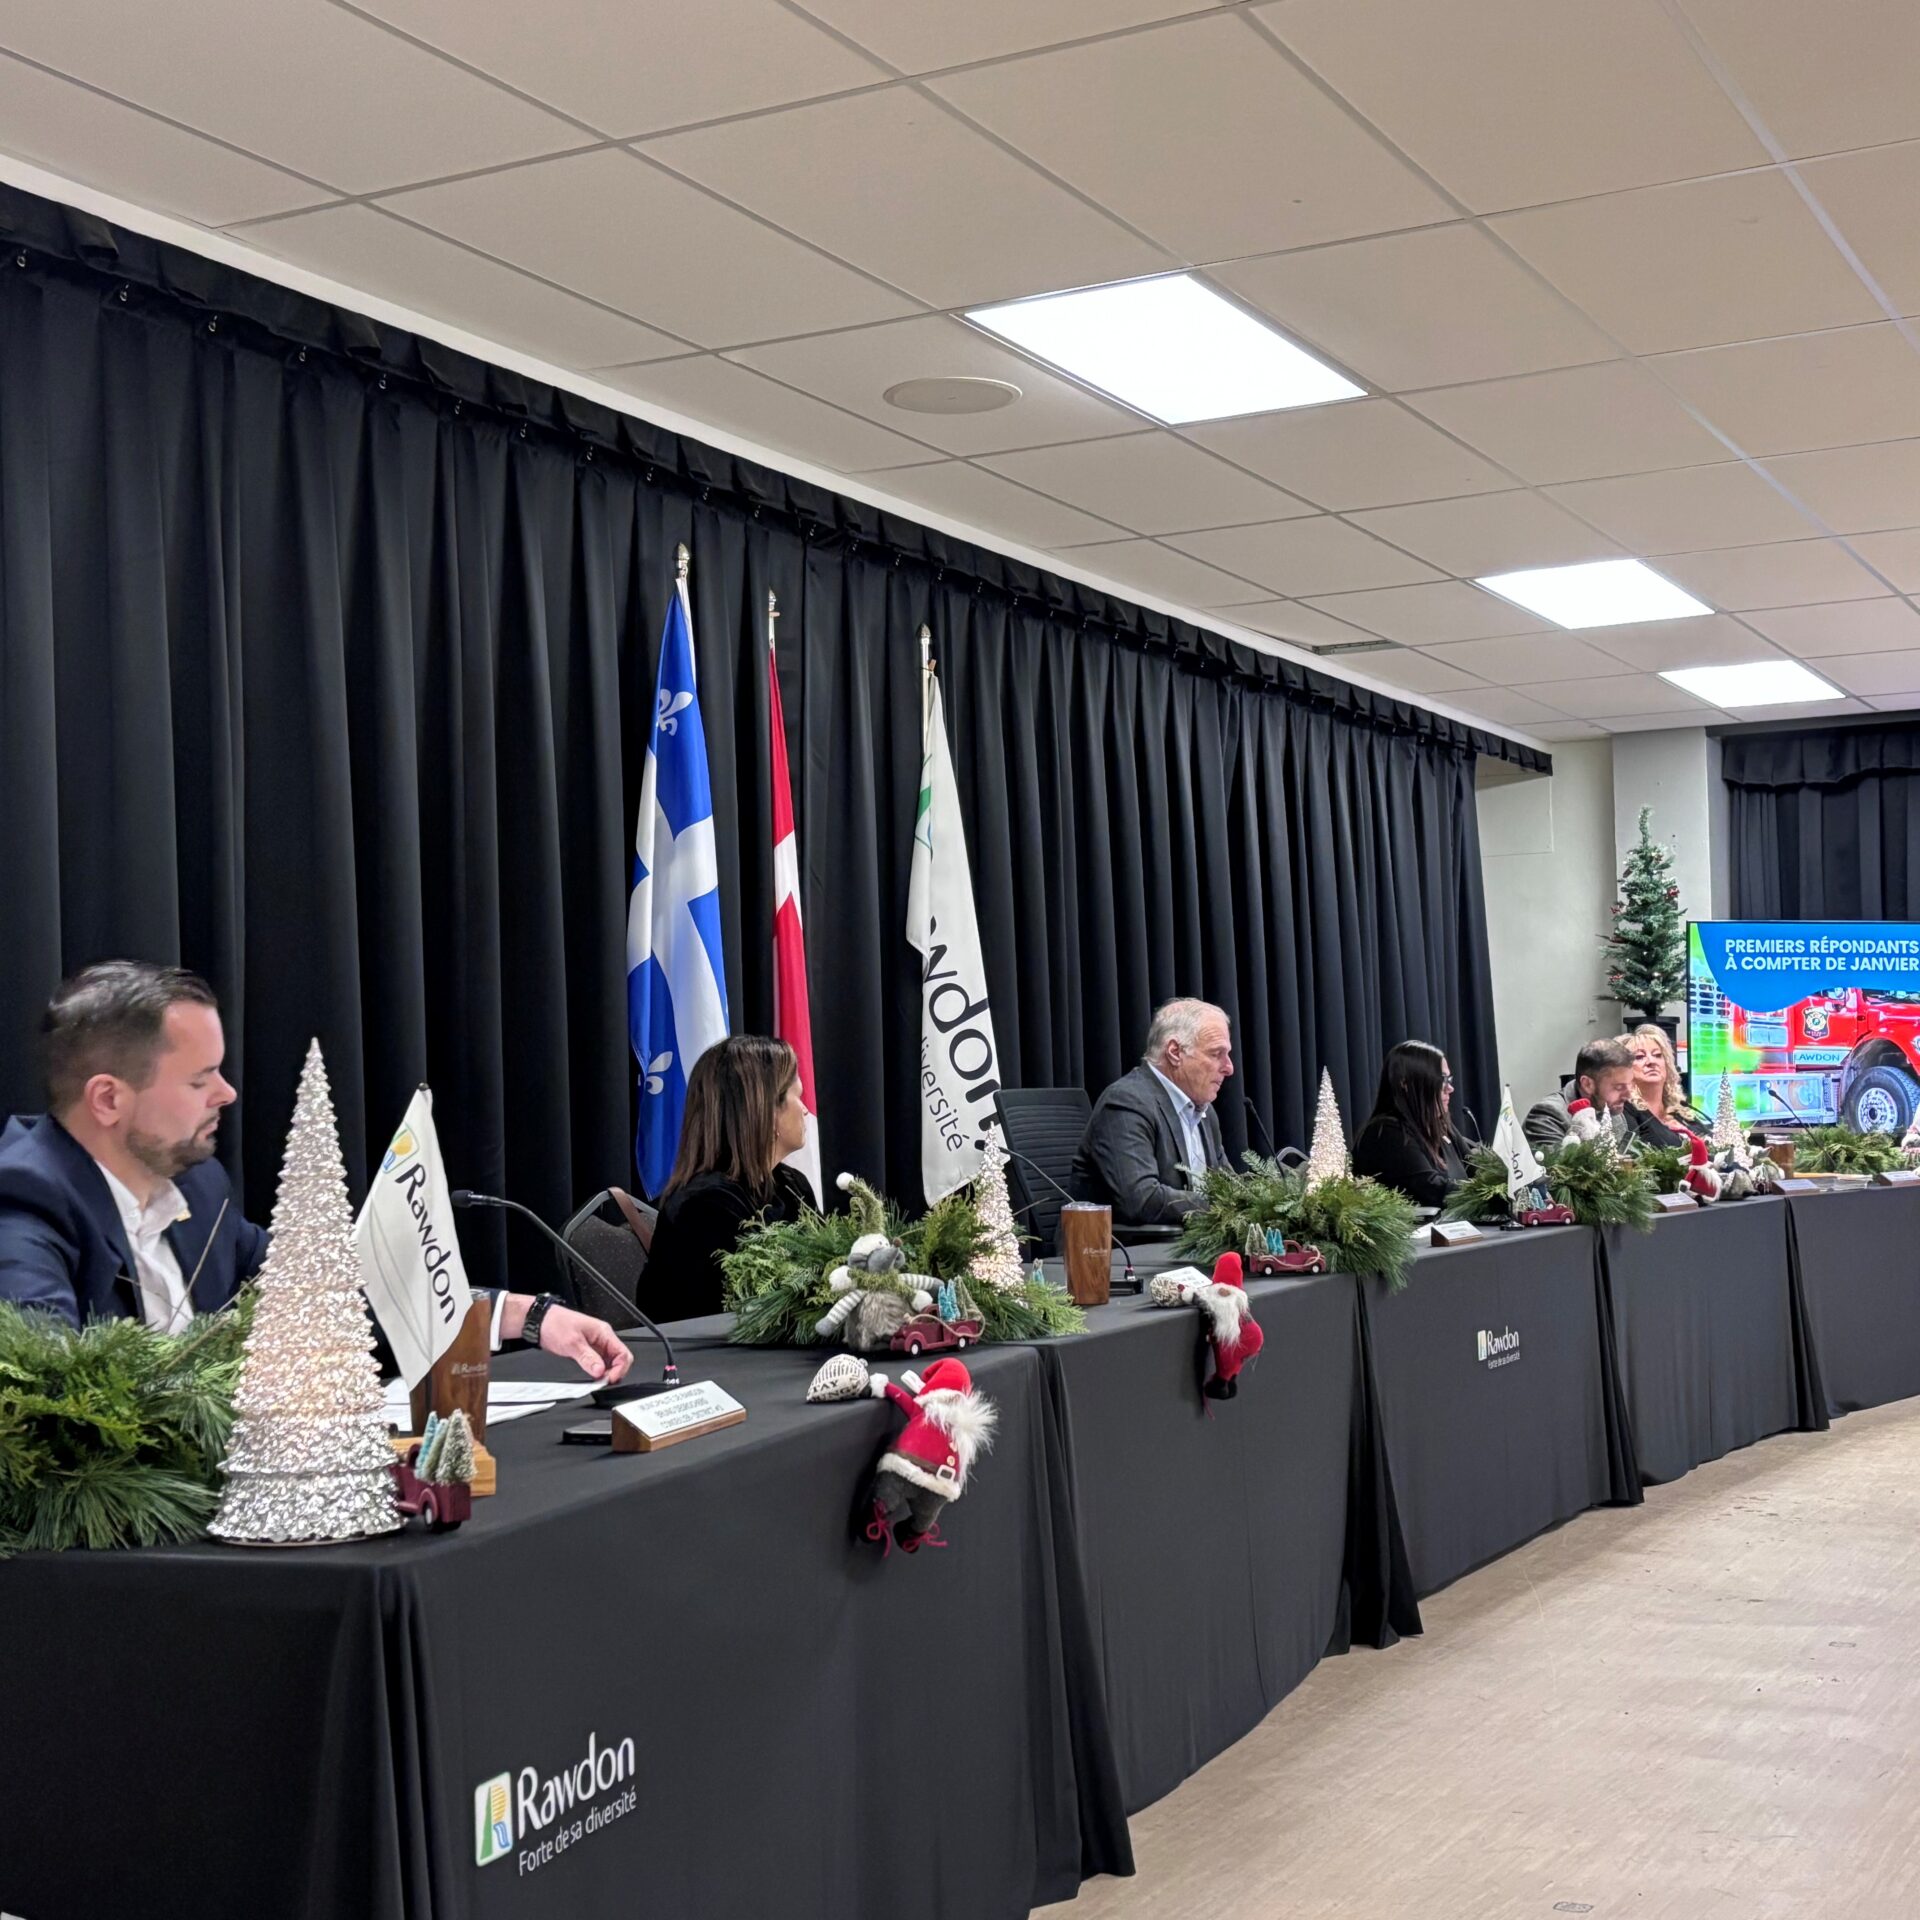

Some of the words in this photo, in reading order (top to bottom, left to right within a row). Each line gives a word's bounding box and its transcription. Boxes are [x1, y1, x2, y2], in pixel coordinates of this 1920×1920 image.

[1725, 939, 1805, 954] PREMIERS
[1809, 936, 1919, 954] RÉPONDANTS
[1725, 953, 1738, 970] À
[1741, 956, 1821, 970] COMPTER
[1825, 957, 1847, 970] DE
[1850, 957, 1919, 971] JANVIER
[1794, 1053, 1840, 1062] AWDON
[395, 1162, 456, 1325] Rawdon
[1487, 1325, 1519, 1356] Rawdon
[517, 1731, 635, 1840] Rawdon
[519, 1840, 553, 1876] Forte
[555, 1826, 569, 1854] de
[570, 1820, 582, 1844] sa
[585, 1785, 637, 1834] diversité
